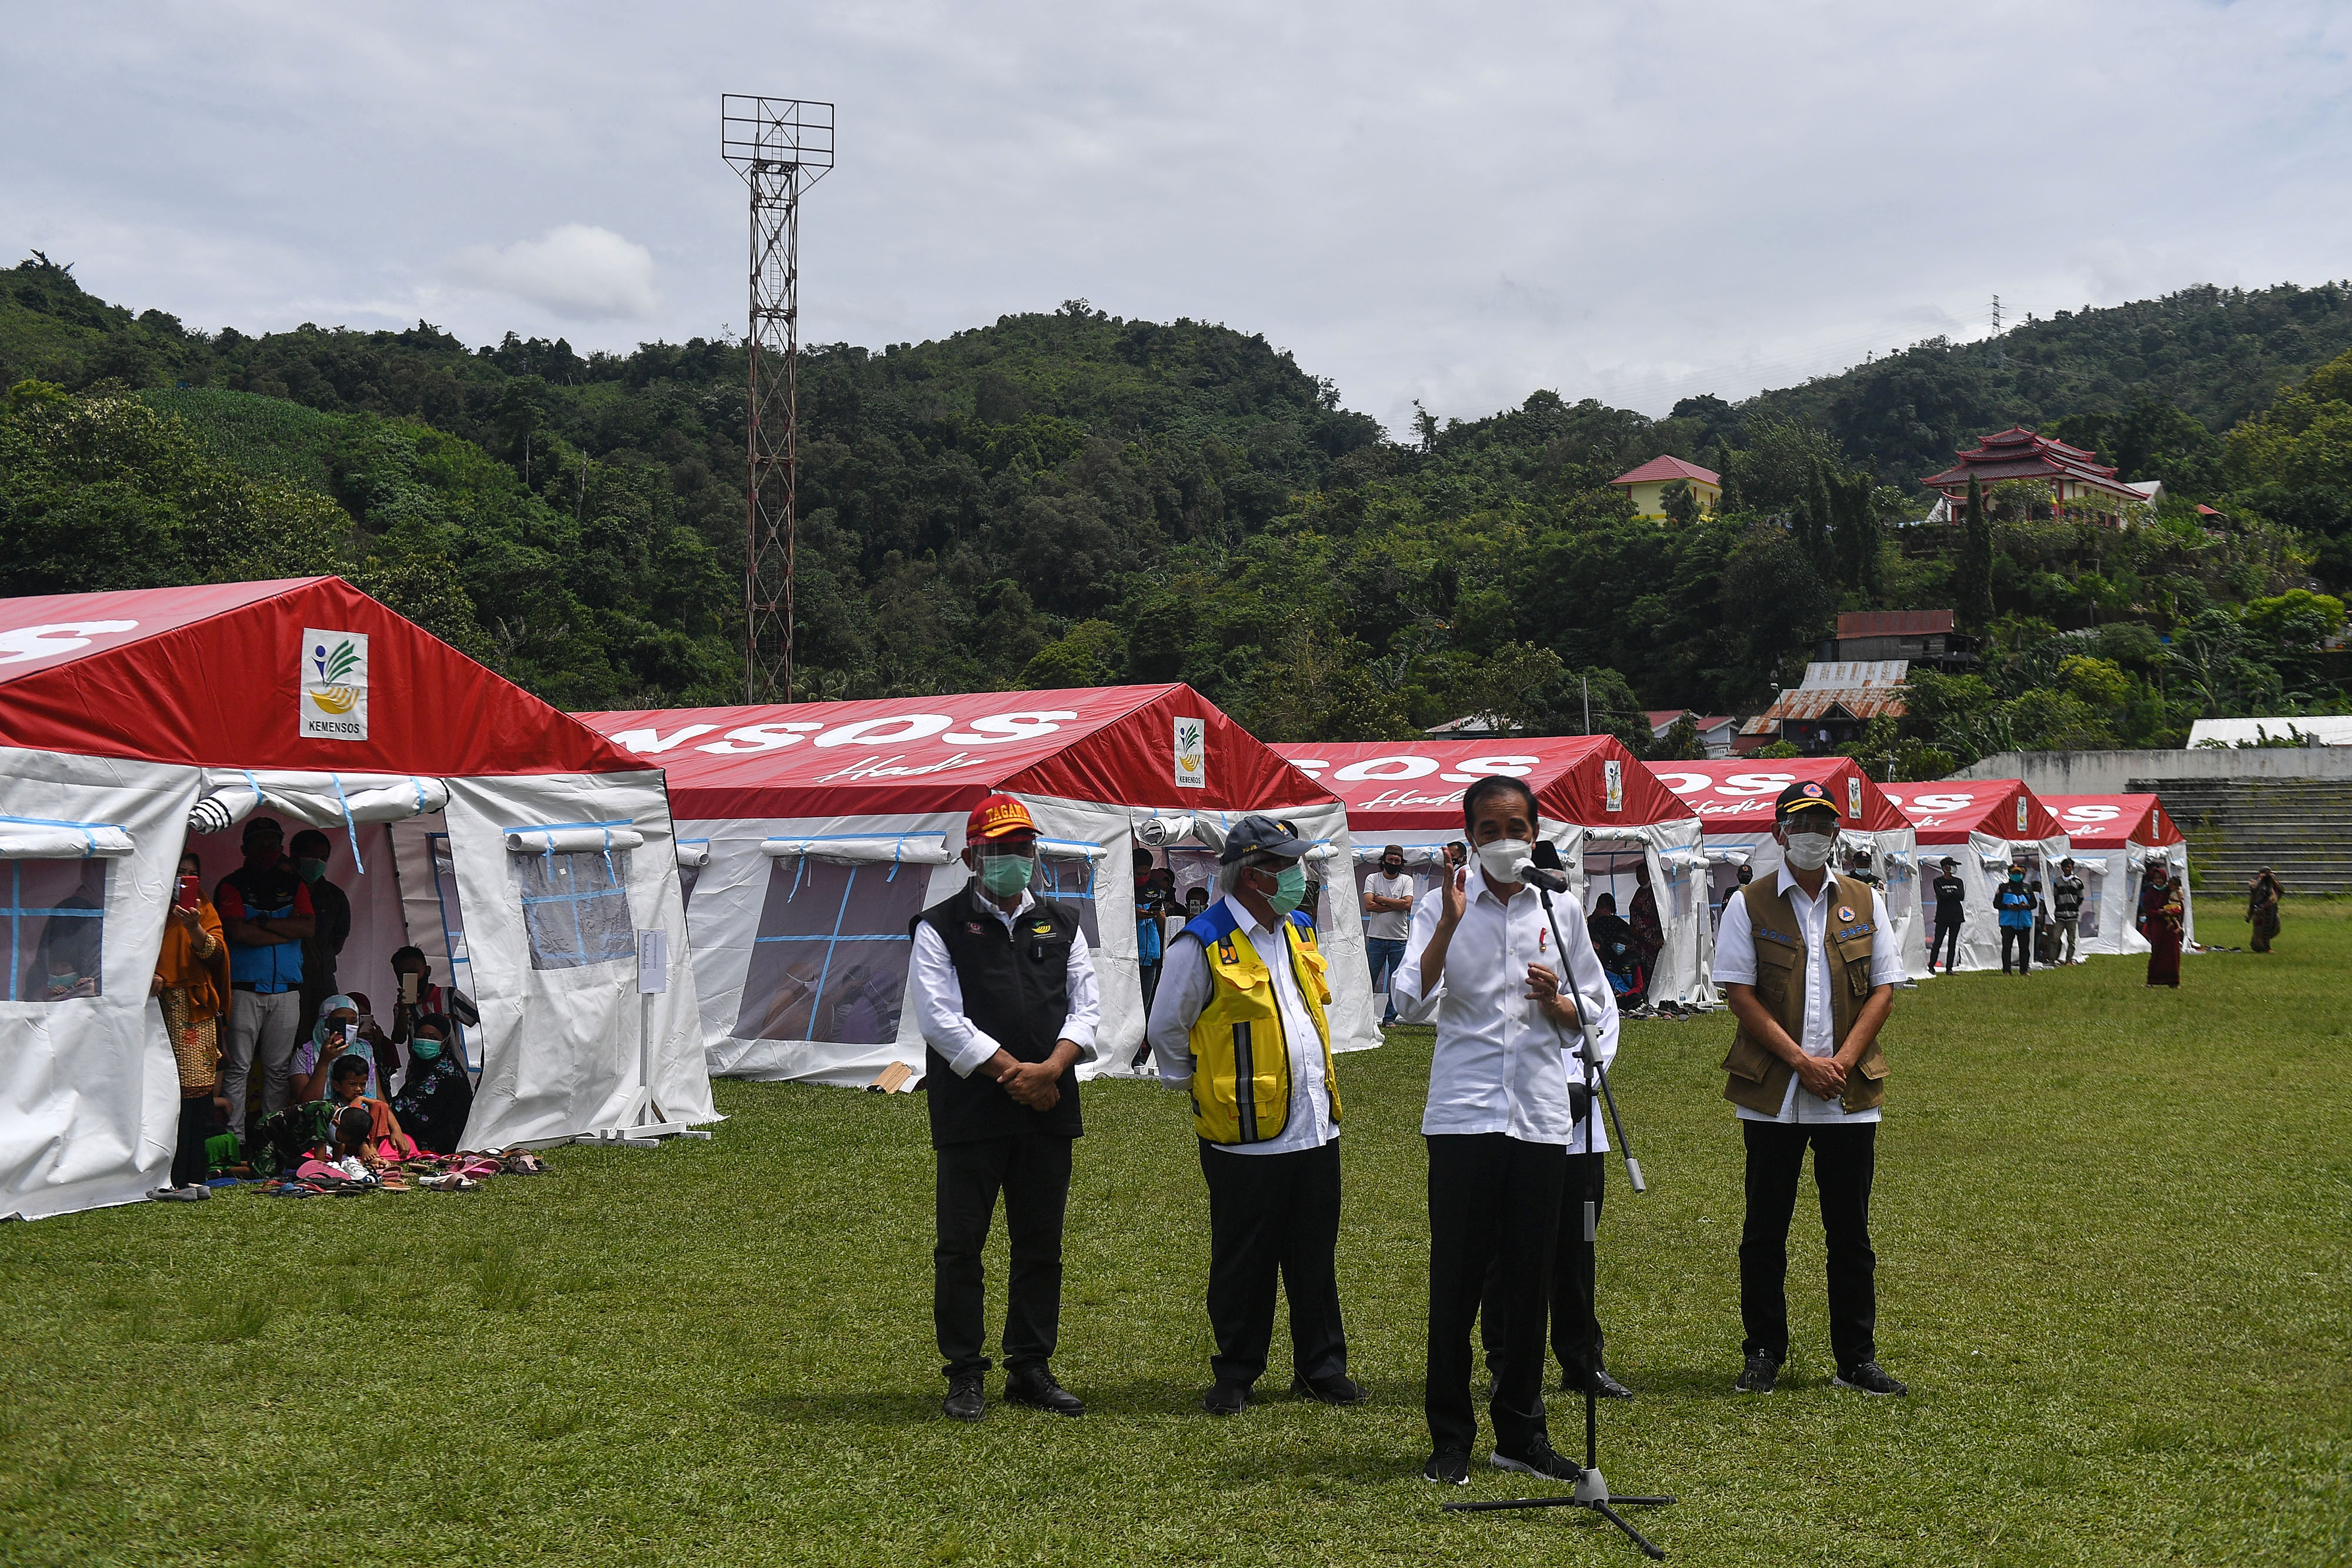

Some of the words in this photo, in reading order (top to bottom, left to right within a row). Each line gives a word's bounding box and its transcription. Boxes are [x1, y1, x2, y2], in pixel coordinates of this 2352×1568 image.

[309, 721, 360, 734] KEMENSOS
[1357, 789, 1466, 810] Hadi
[985, 803, 1030, 823] TAGANA
[1760, 928, 1792, 944] DONI
[1840, 924, 1869, 938] BNPB
